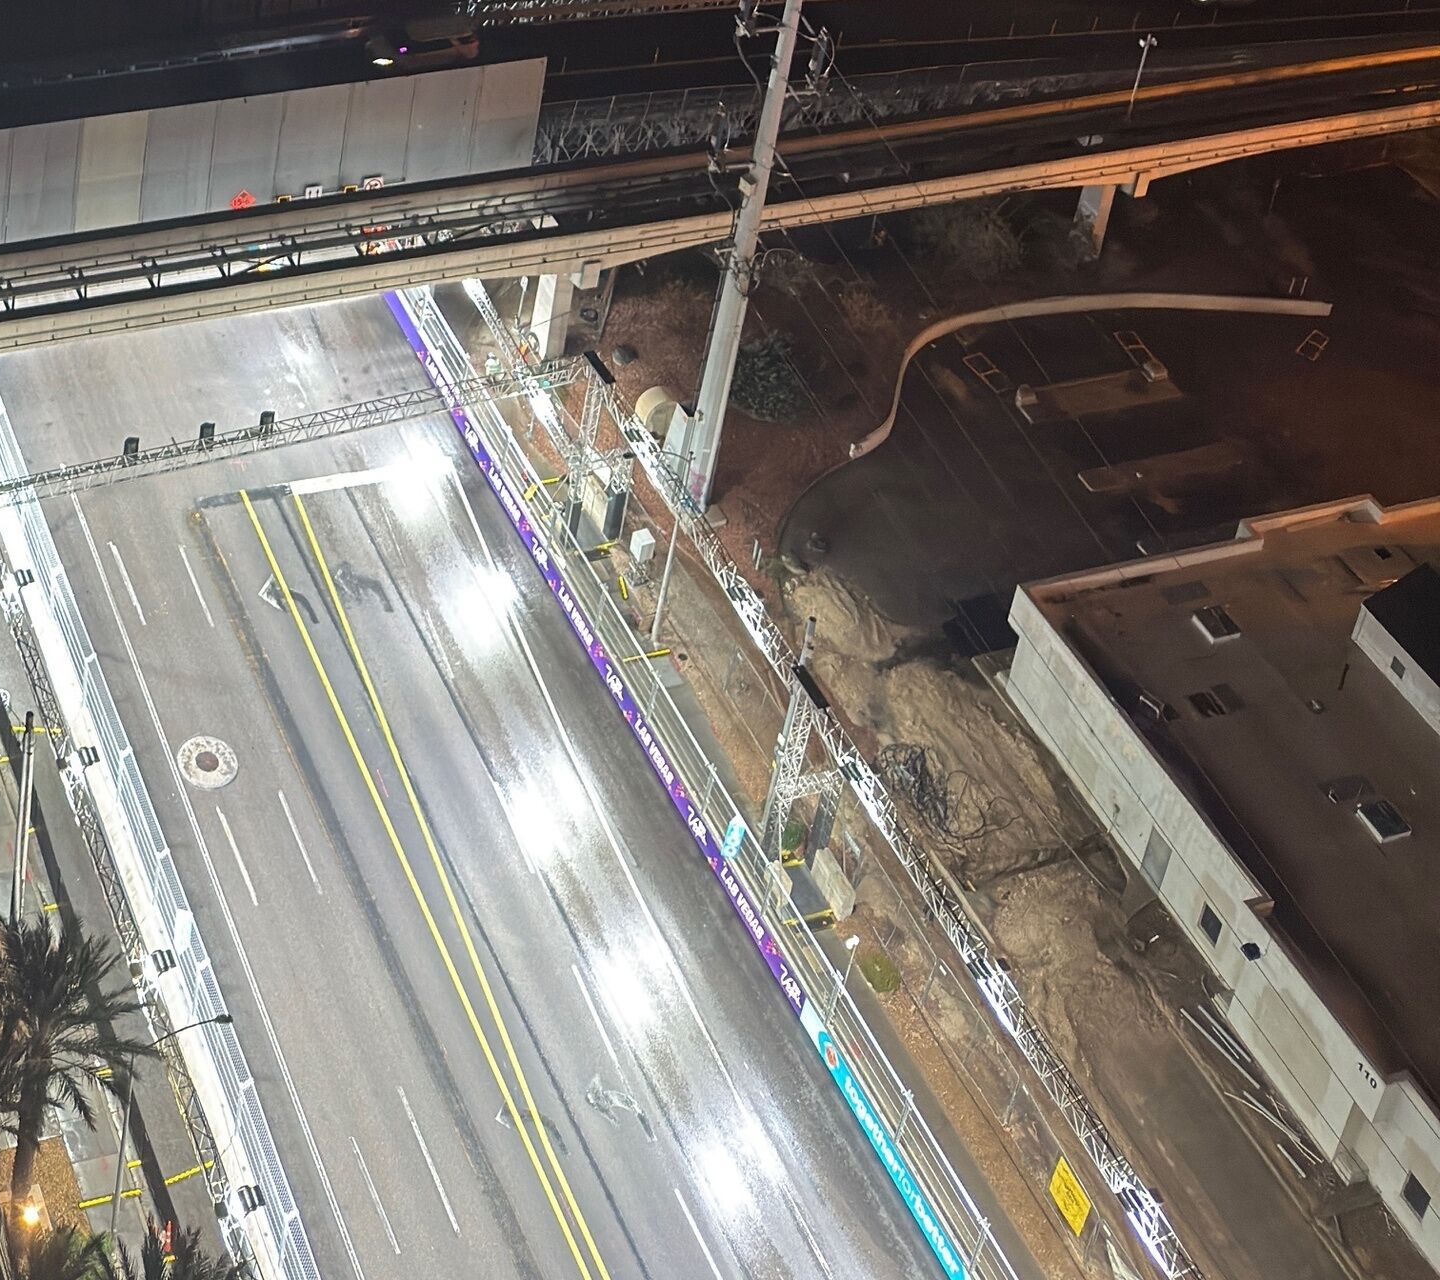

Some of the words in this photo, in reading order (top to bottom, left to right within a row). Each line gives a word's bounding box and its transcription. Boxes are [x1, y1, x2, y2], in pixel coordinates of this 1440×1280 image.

[558, 586, 575, 613] LAS
[570, 607, 595, 647] VEGAS
[634, 718, 654, 746] LAS
[648, 742, 674, 785] VEGAS
[719, 866, 740, 898] LAS
[736, 892, 765, 939] VEGAS
[1358, 1062, 1377, 1089] 110
